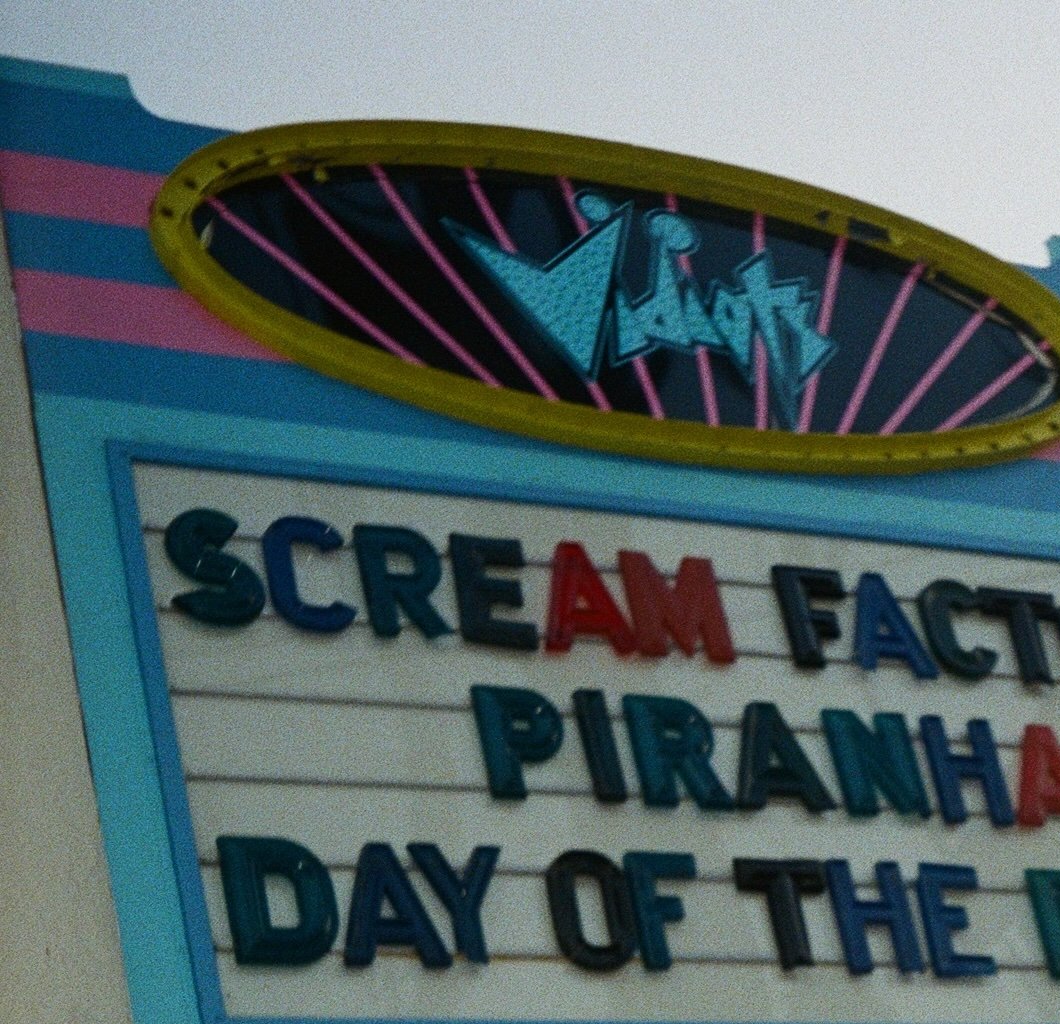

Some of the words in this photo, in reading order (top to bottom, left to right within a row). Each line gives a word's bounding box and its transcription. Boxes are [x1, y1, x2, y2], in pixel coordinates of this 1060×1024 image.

[164, 508, 737, 665] SCREAM
[216, 835, 500, 969] DAY
[545, 849, 698, 972] OF
[733, 857, 998, 979] THE
